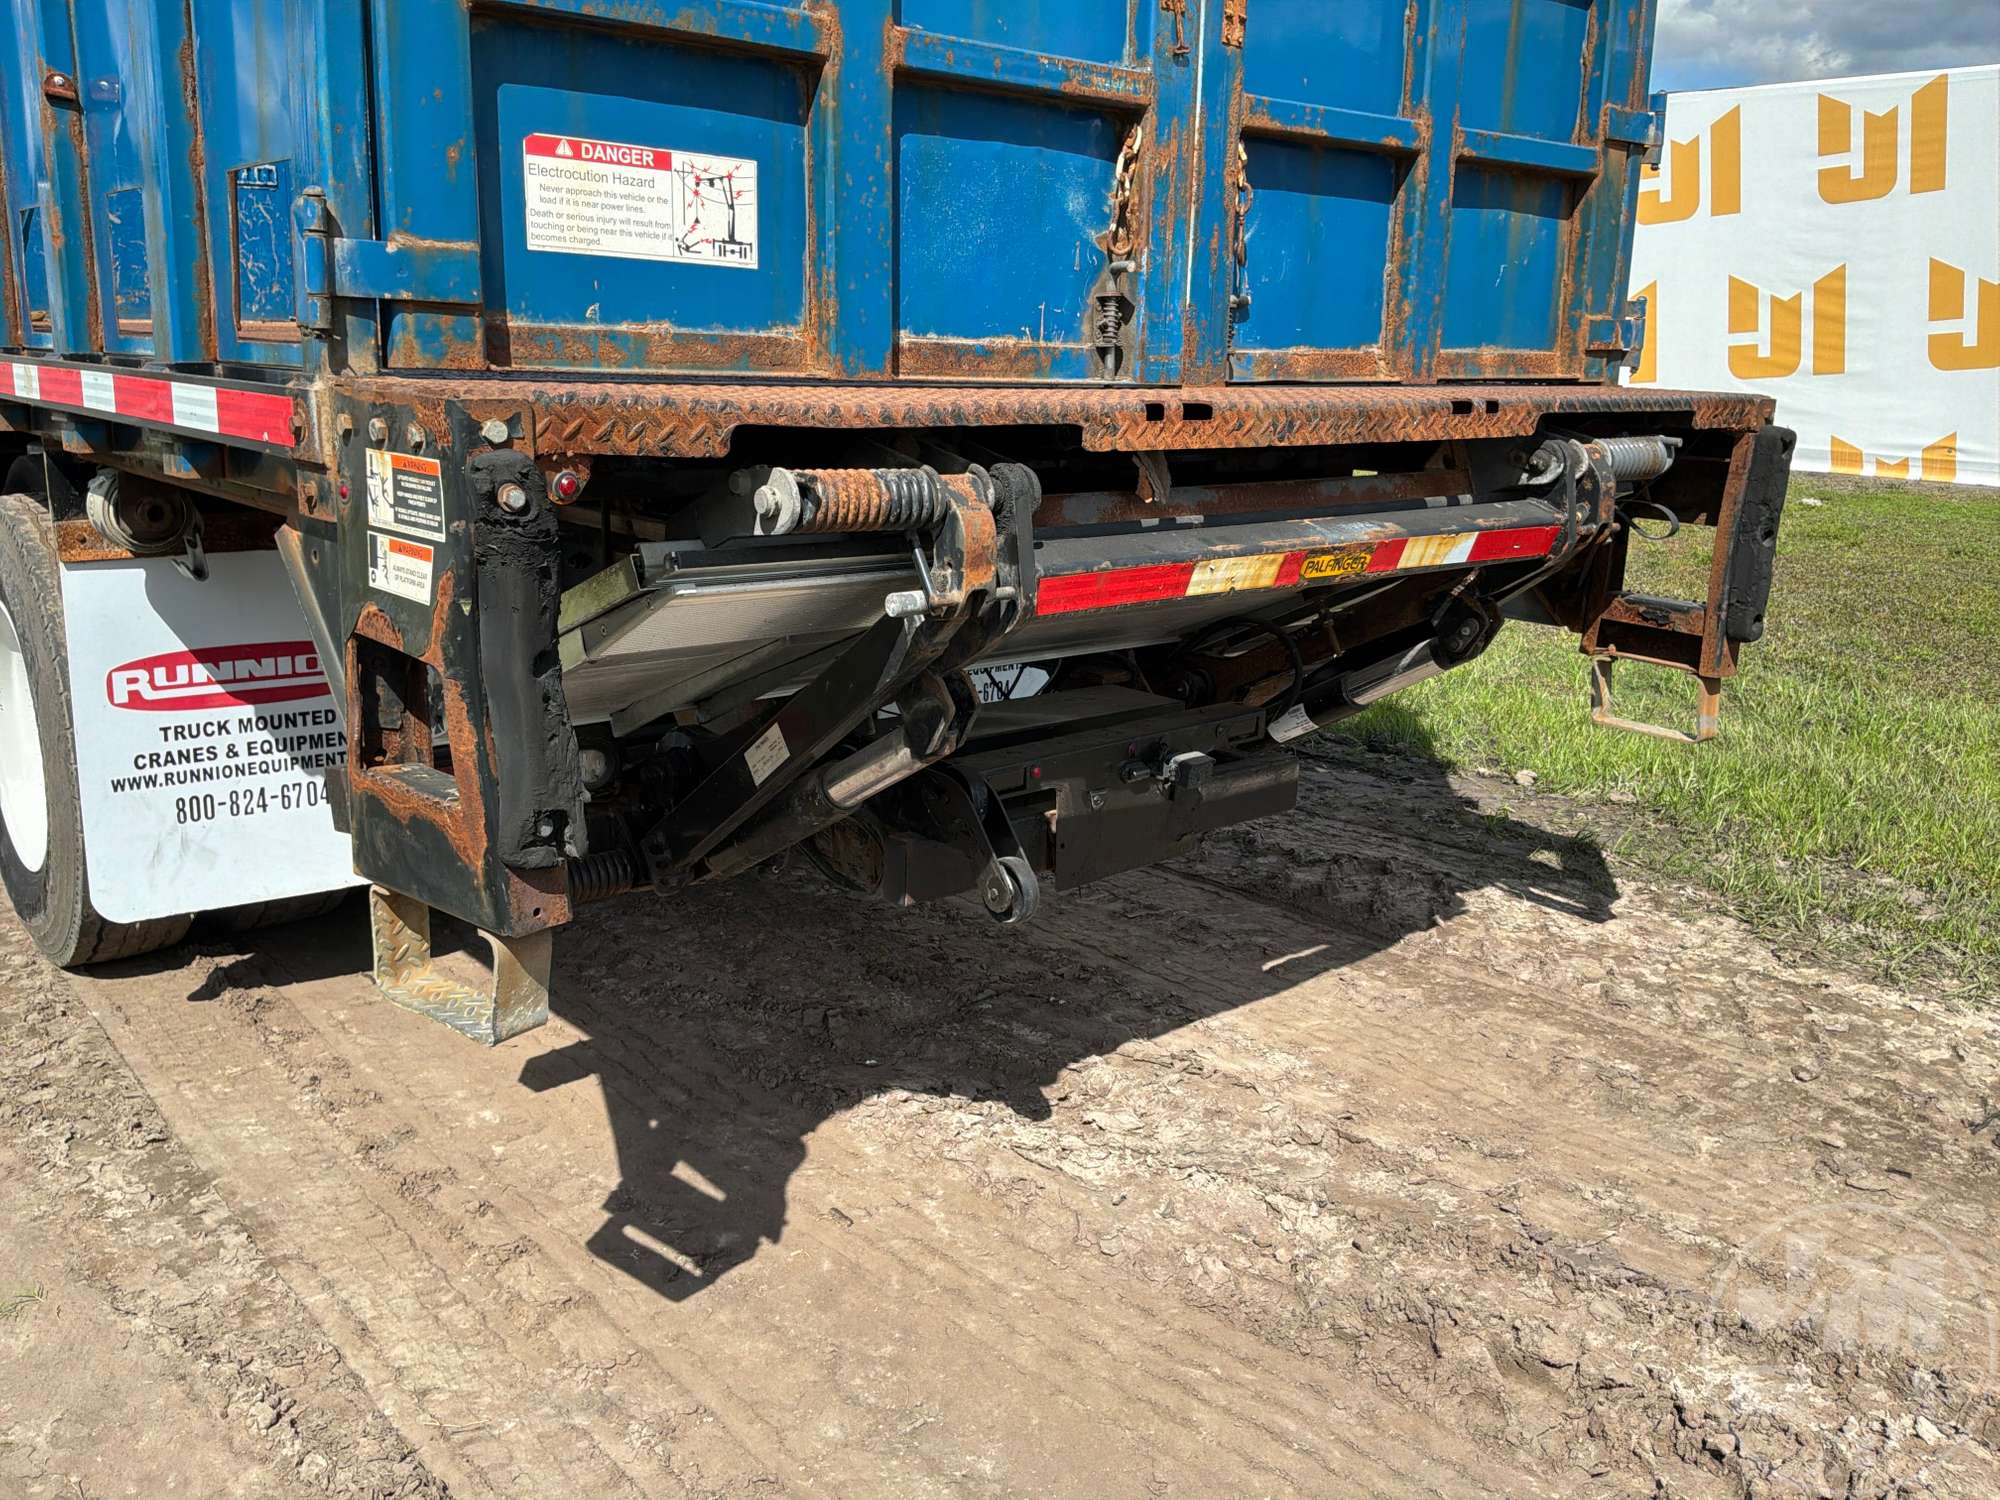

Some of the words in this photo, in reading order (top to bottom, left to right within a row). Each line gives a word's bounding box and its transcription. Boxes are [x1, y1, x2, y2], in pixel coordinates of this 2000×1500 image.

[581, 143, 654, 167] DANGER
[528, 163, 608, 184] Electrocution
[612, 172, 655, 188] Hazard
[540, 184, 563, 193] Never
[566, 188, 601, 198] approach
[604, 190, 617, 199] this
[619, 192, 645, 202] vehicle
[657, 196, 668, 204] the
[540, 196, 556, 204] load
[601, 203, 623, 213] power
[530, 208, 553, 218] Death
[566, 212, 594, 222] serious
[596, 215, 616, 225] injury
[619, 216, 631, 225] will
[633, 218, 653, 228] result
[655, 220, 671, 229] from
[531, 221, 564, 233] touching
[577, 224, 598, 235] being
[619, 229, 632, 237] this
[635, 231, 660, 240] vehicle
[531, 232, 566, 242] becomes
[1304, 556, 1367, 574] PALFINGER
[973, 680, 1009, 702] -6704
[159, 720, 231, 742] TRUCK
[238, 709, 336, 734] MOUNTED
[134, 745, 218, 770] CRANES
[225, 743, 239, 759] &
[111, 752, 346, 792] WWW.RUNNIONEQUIPMENT
[176, 780, 329, 824] 800-824-6704
